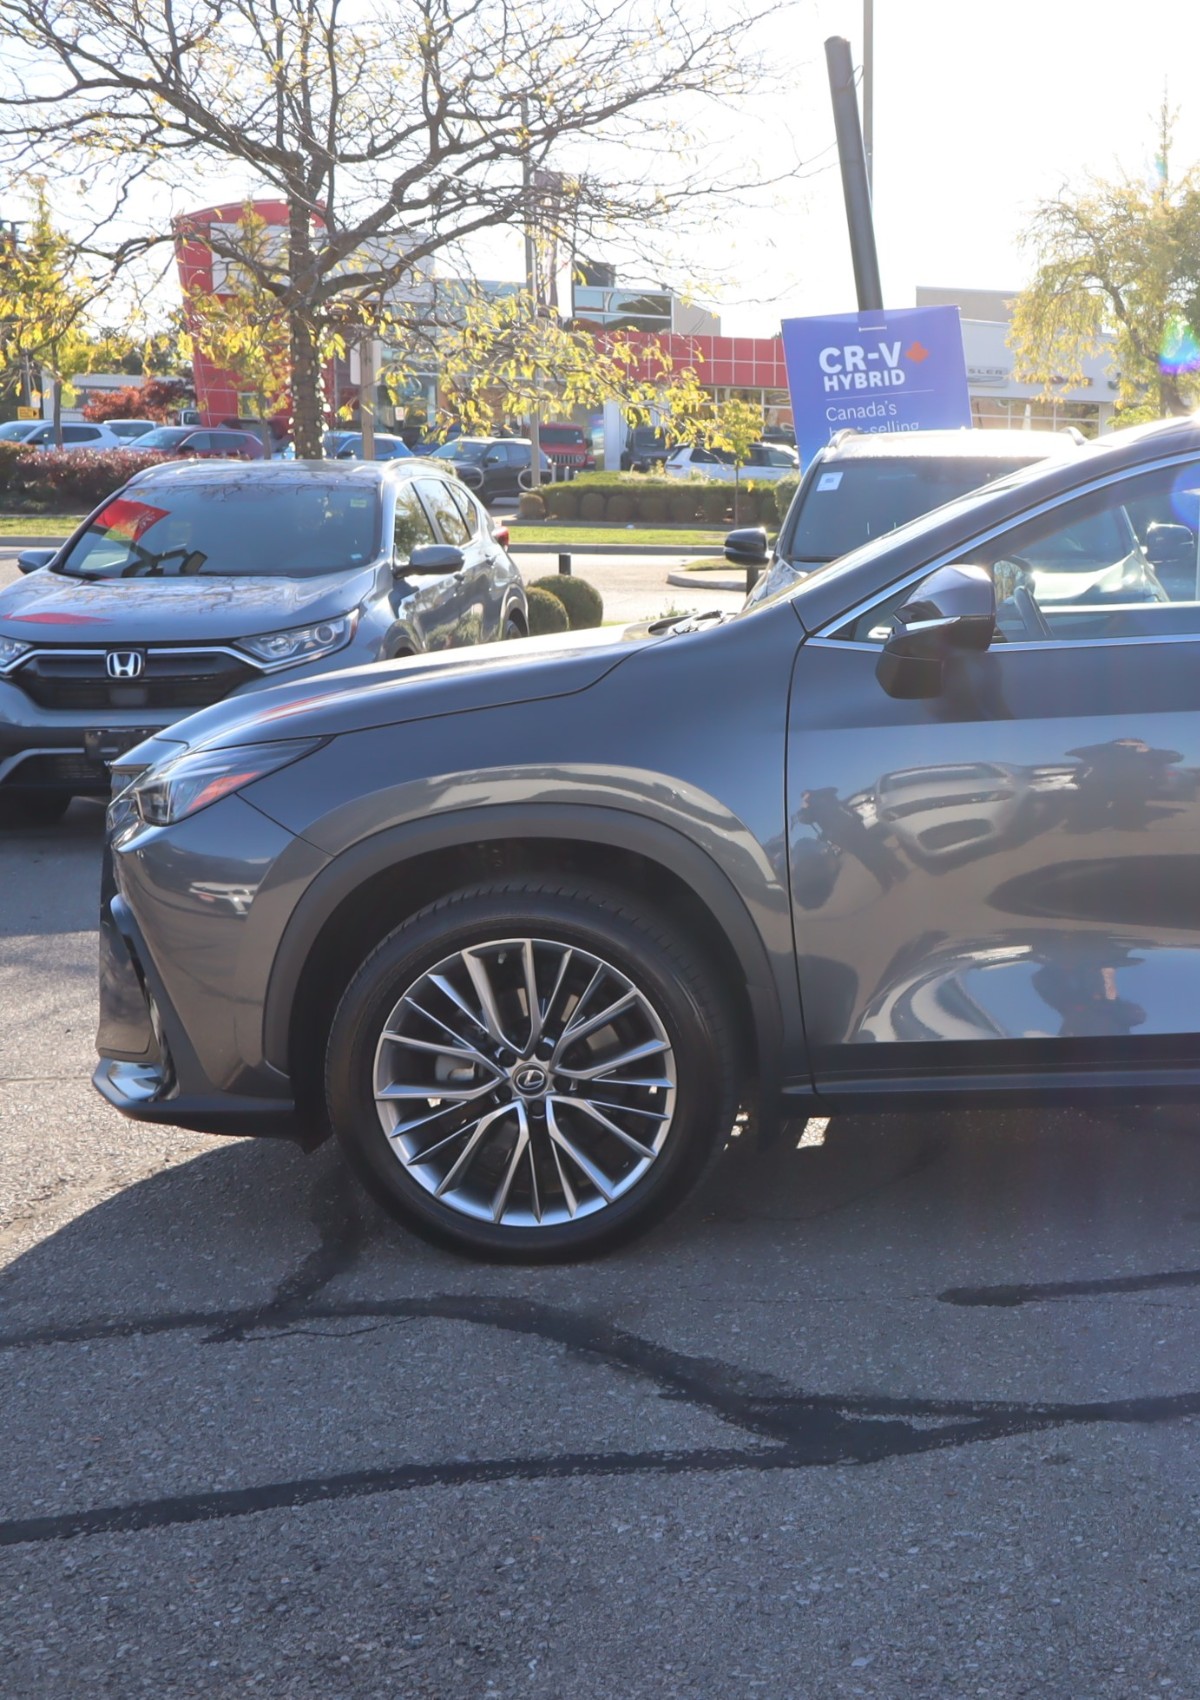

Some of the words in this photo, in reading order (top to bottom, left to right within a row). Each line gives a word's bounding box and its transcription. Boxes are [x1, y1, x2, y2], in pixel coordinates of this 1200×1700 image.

[819, 341, 902, 374] CR-V
[823, 369, 906, 392] HYBRID
[826, 400, 897, 421] Canada's
